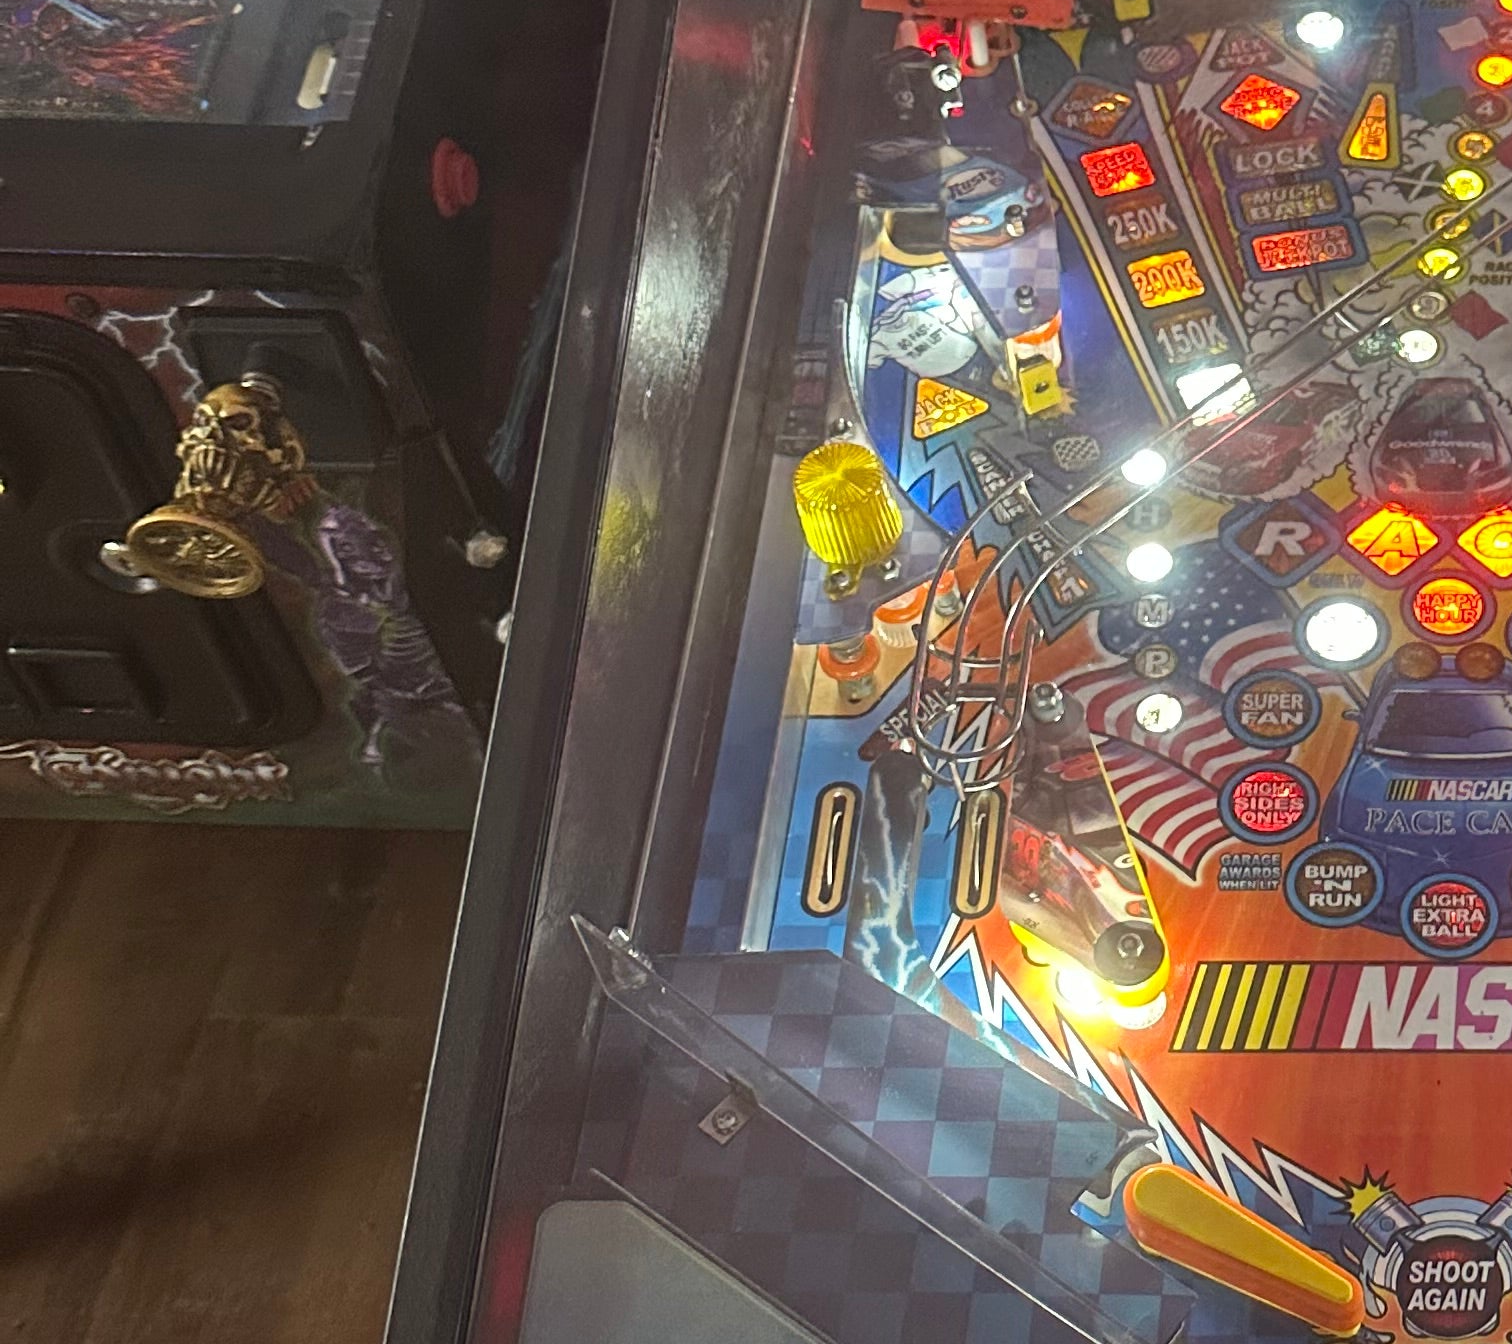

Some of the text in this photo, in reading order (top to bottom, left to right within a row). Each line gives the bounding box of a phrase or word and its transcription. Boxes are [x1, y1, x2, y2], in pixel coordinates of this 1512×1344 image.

[1235, 143, 1320, 173] LOCK
[1107, 203, 1179, 245] 250K
[1131, 258, 1204, 302] 200K
[1156, 314, 1229, 357] 150K
[1254, 521, 1312, 555] R
[1366, 520, 1421, 558] A
[1415, 594, 1483, 609] HAPPY
[1141, 598, 1168, 621] M
[1420, 608, 1479, 624] HOUR
[1241, 693, 1304, 711] SUPER
[1240, 712, 1304, 726] FAN
[1240, 782, 1298, 797] RIGHT
[1234, 797, 1305, 812] SIDES
[1241, 811, 1301, 826] ONLY
[1364, 807, 1457, 836] PACE
[1220, 854, 1281, 866] GARAGE
[1219, 867, 1281, 879] AWARDS
[1304, 865, 1369, 879] BUMP
[1219, 880, 1281, 890] WHEN LIT
[1308, 893, 1362, 907] RUN
[1420, 894, 1478, 907] LIGHT
[1412, 908, 1486, 923] EXTRA
[1421, 924, 1479, 937] BALL
[1408, 1260, 1495, 1283] SHOOT
[1407, 1287, 1486, 1311] AGAIN
